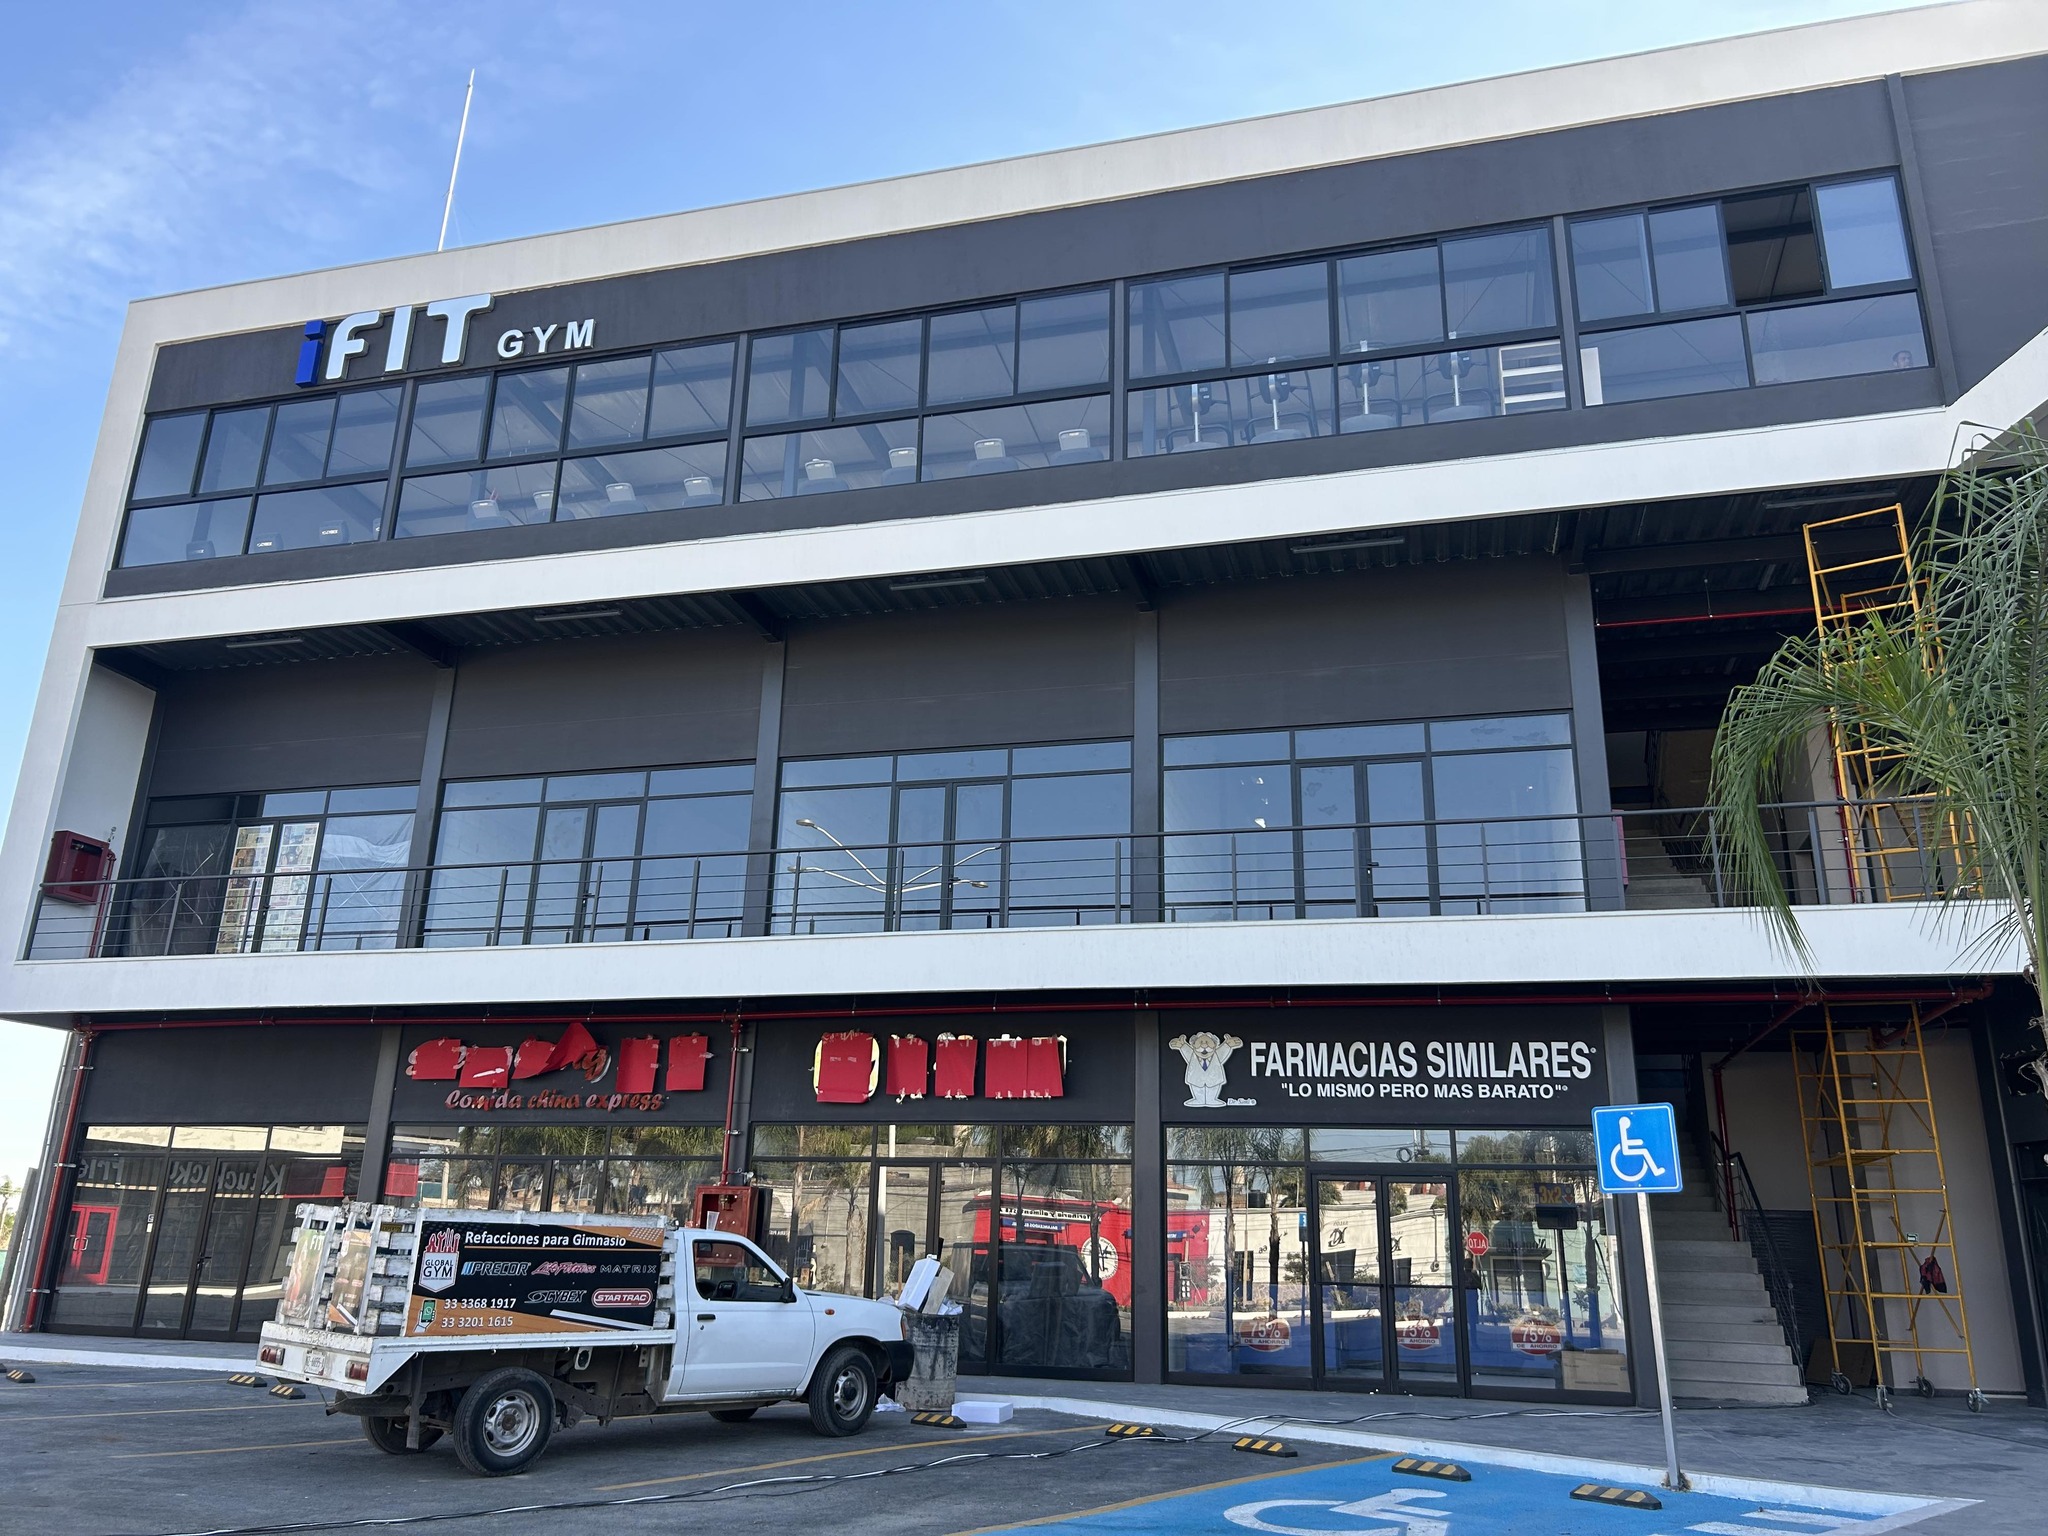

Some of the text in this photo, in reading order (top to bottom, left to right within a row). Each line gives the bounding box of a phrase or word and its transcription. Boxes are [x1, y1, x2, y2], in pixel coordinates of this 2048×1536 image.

[497, 318, 597, 359] GYM
[1250, 1041, 1419, 1079] FARMACIAS
[1281, 1082, 1313, 1098] "LO
[1317, 1083, 1375, 1099] MISMO
[1380, 1083, 1429, 1099] PERO
[1433, 1083, 1474, 1099] MAS
[444, 1088, 666, 1112] Comida china express
[464, 1231, 627, 1248] Refacciones para Gimnasio
[424, 1259, 454, 1267] GLOBAL
[470, 1262, 530, 1276] PRECOR
[600, 1264, 658, 1274] MATRIX
[423, 1266, 453, 1278] GYM
[443, 1298, 517, 1309] 33 3368 1917
[547, 1290, 585, 1304] CYBEX
[596, 1294, 648, 1302] STAR TRAC
[441, 1316, 515, 1328] 33 3201 1615
[1250, 1321, 1281, 1338] 75%
[1520, 1327, 1552, 1343] 75%
